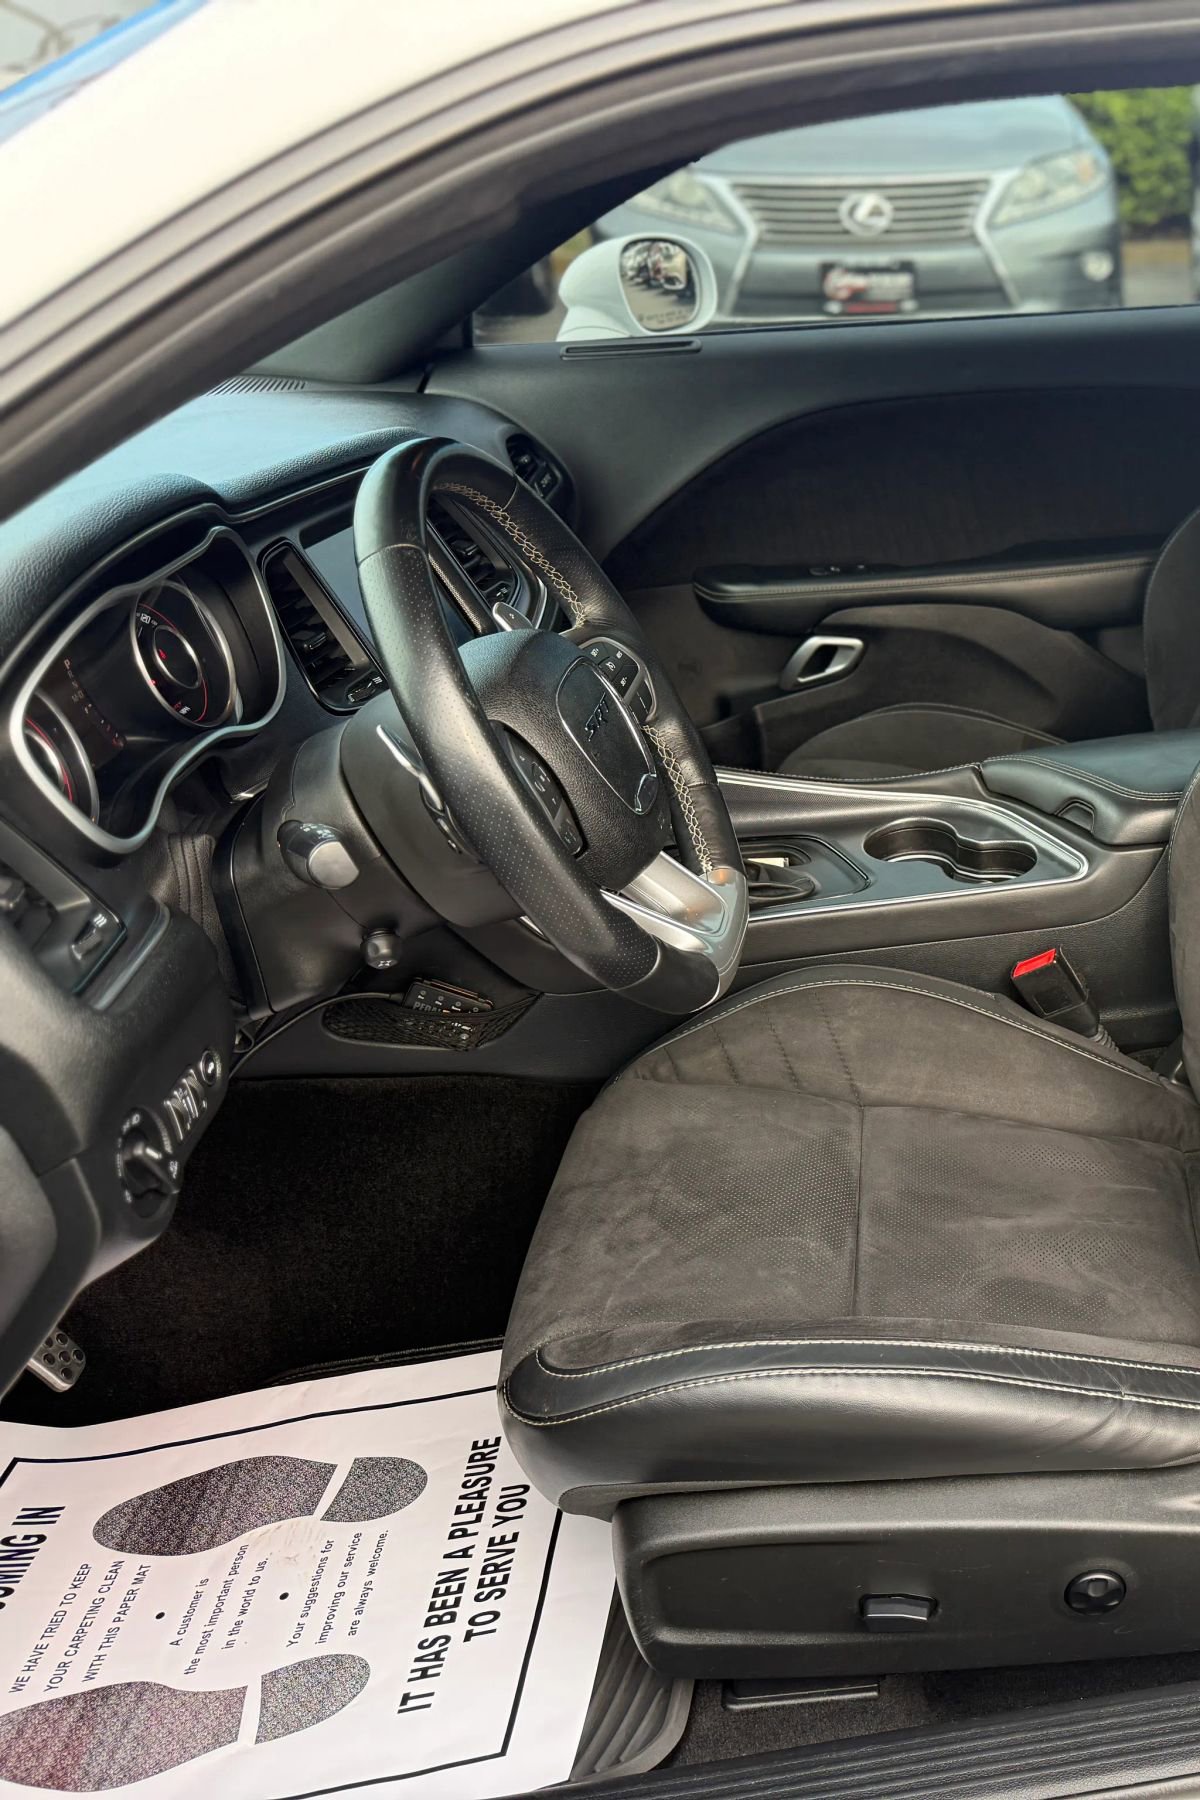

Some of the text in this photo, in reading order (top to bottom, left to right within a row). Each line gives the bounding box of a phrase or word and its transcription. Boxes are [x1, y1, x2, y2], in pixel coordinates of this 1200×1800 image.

[0, 1505, 66, 1609] MING IN
[169, 1577, 209, 1646] A customer is
[184, 1543, 249, 1676] the most important person
[222, 1558, 269, 1650] in the world to us.
[286, 1539, 335, 1648] Your suggestions for
[315, 1532, 363, 1645] improving our service
[348, 1529, 389, 1637] are always welcome.
[397, 1436, 502, 1715] IT HAS BEEN A PLEASURE
[463, 1483, 531, 1643] TO SERVE YOU
[9, 1563, 92, 1694] WE HAVE TRIED TO KEEP
[44, 1560, 125, 1693] YOUR CARPETING CLEAN
[82, 1563, 152, 1683] WITH THIS PAPER MAT
